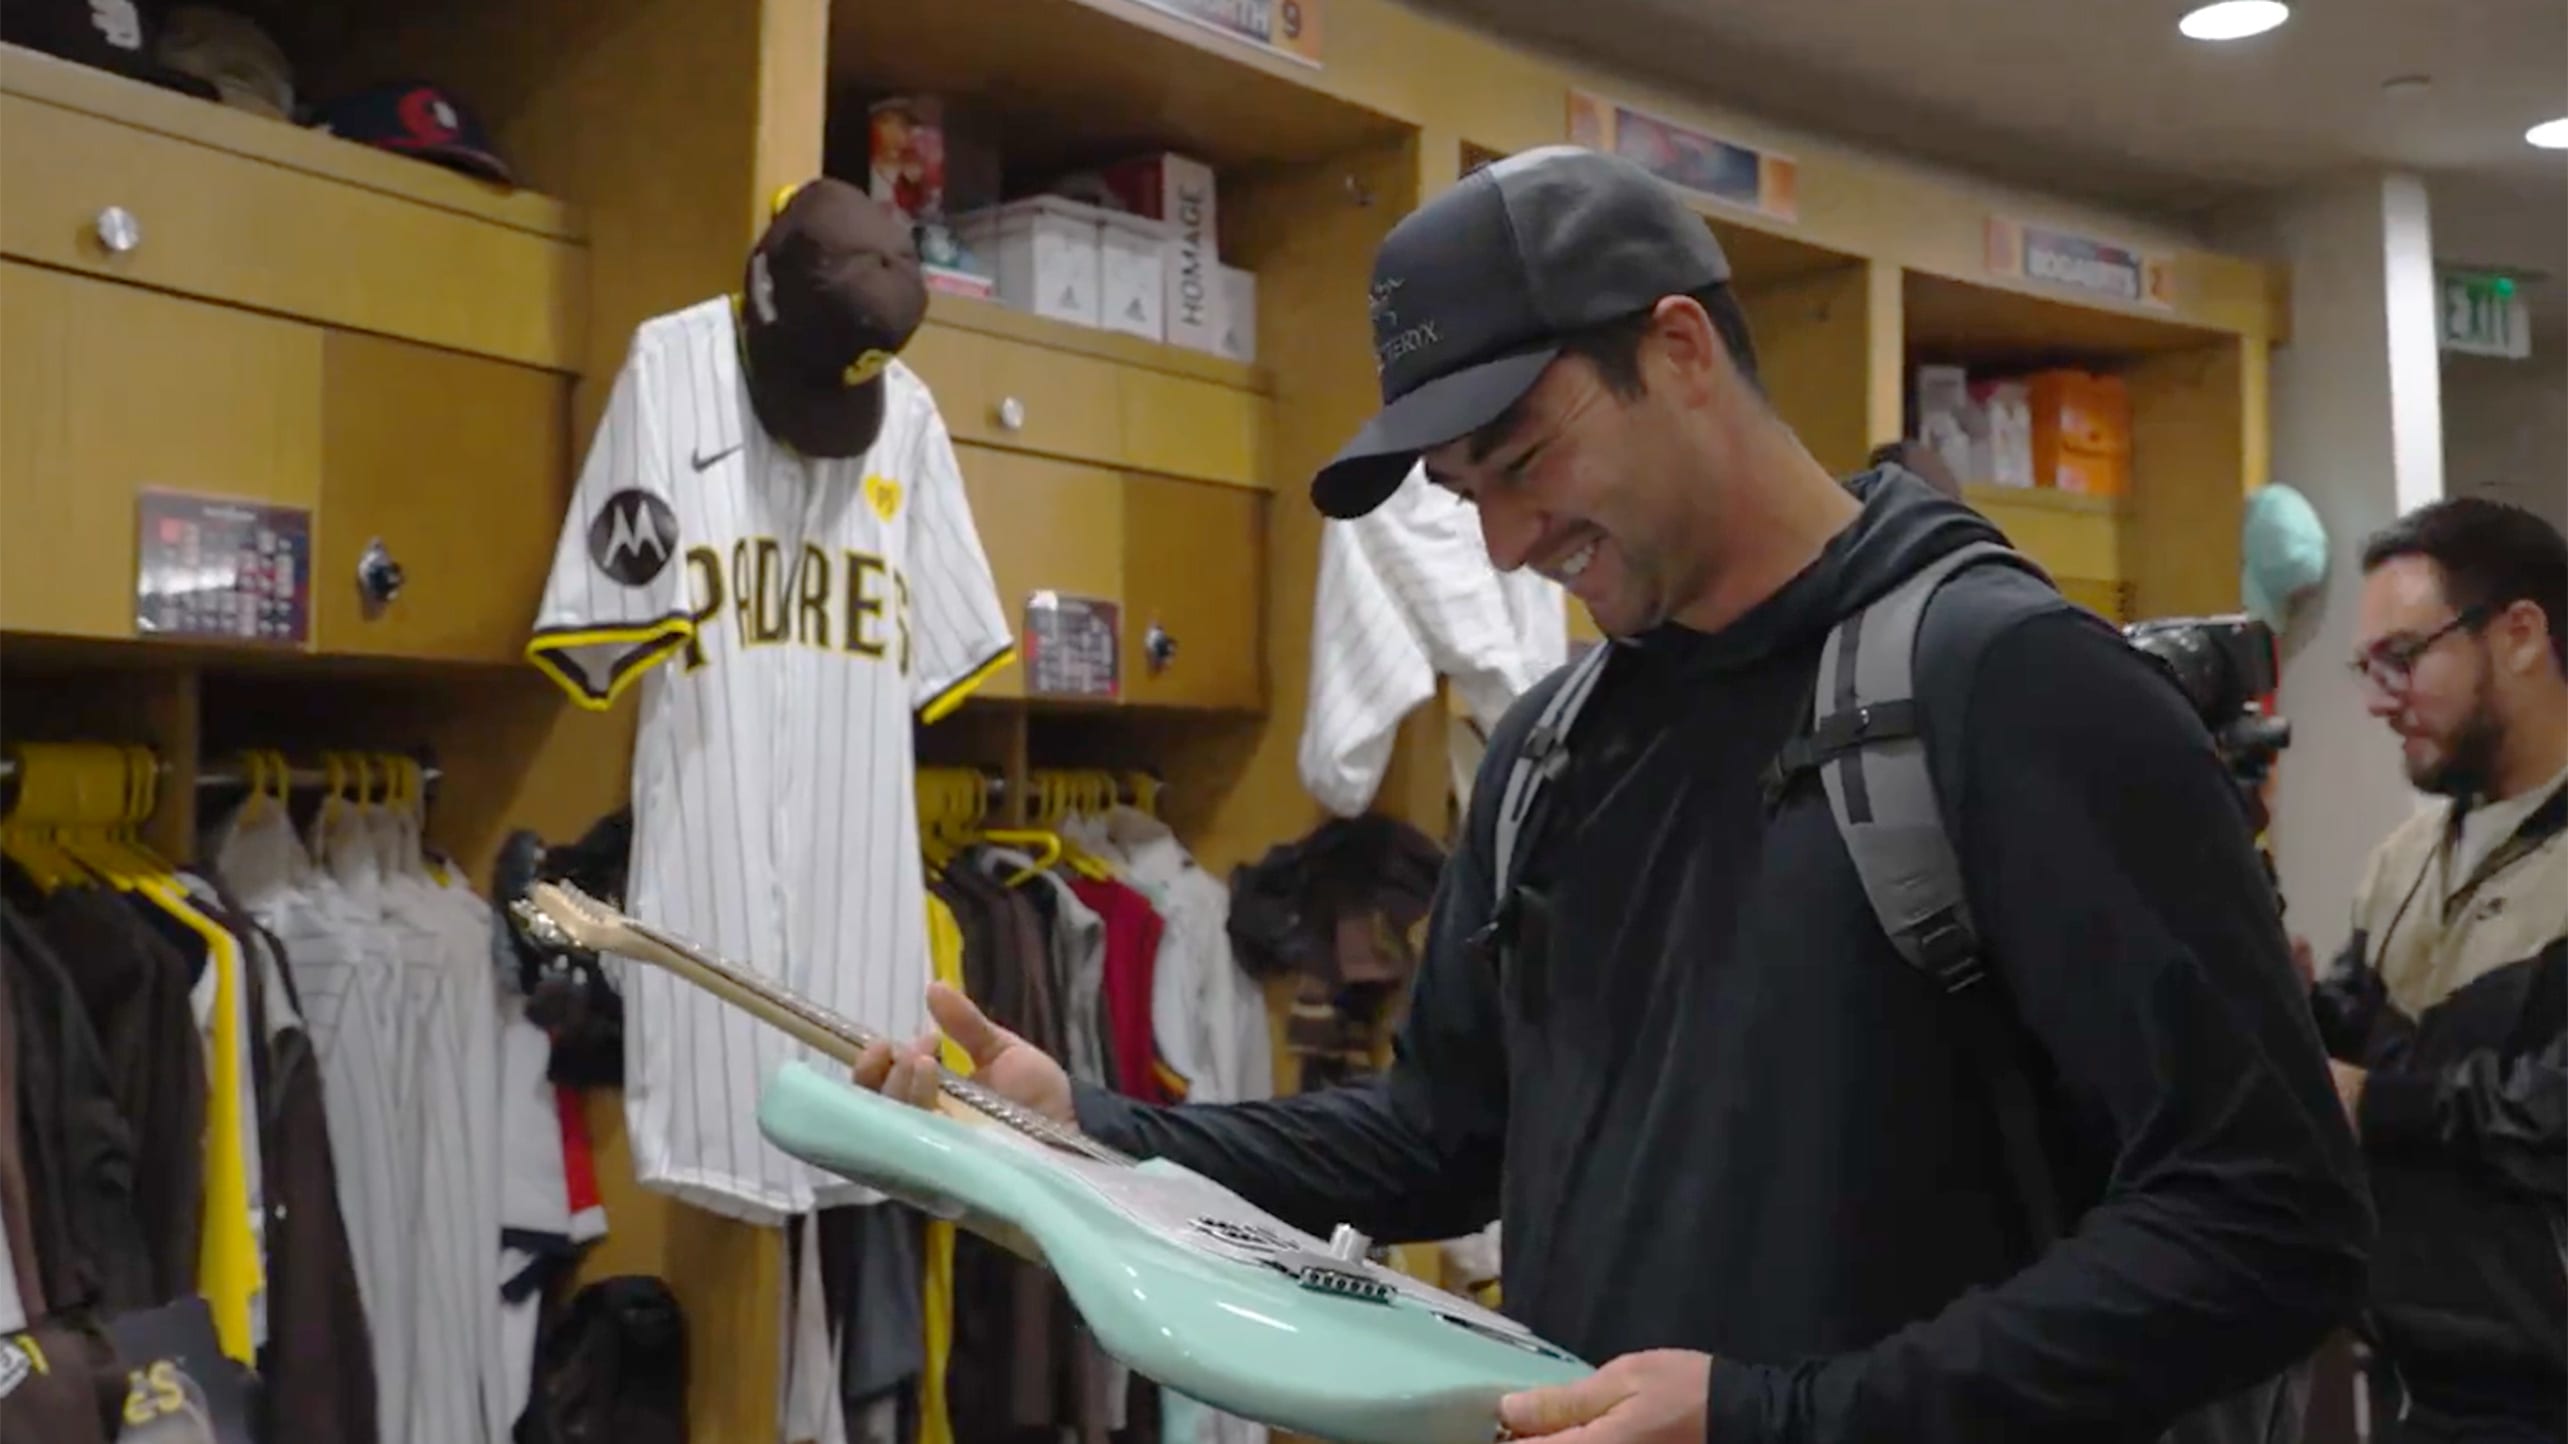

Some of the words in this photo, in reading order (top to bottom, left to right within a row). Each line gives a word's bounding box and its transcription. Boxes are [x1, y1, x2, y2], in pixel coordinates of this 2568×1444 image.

[1281, 0, 1302, 39] 9
[1178, 184, 1204, 326] HOMAGE
[2444, 278, 2512, 351] EXIT
